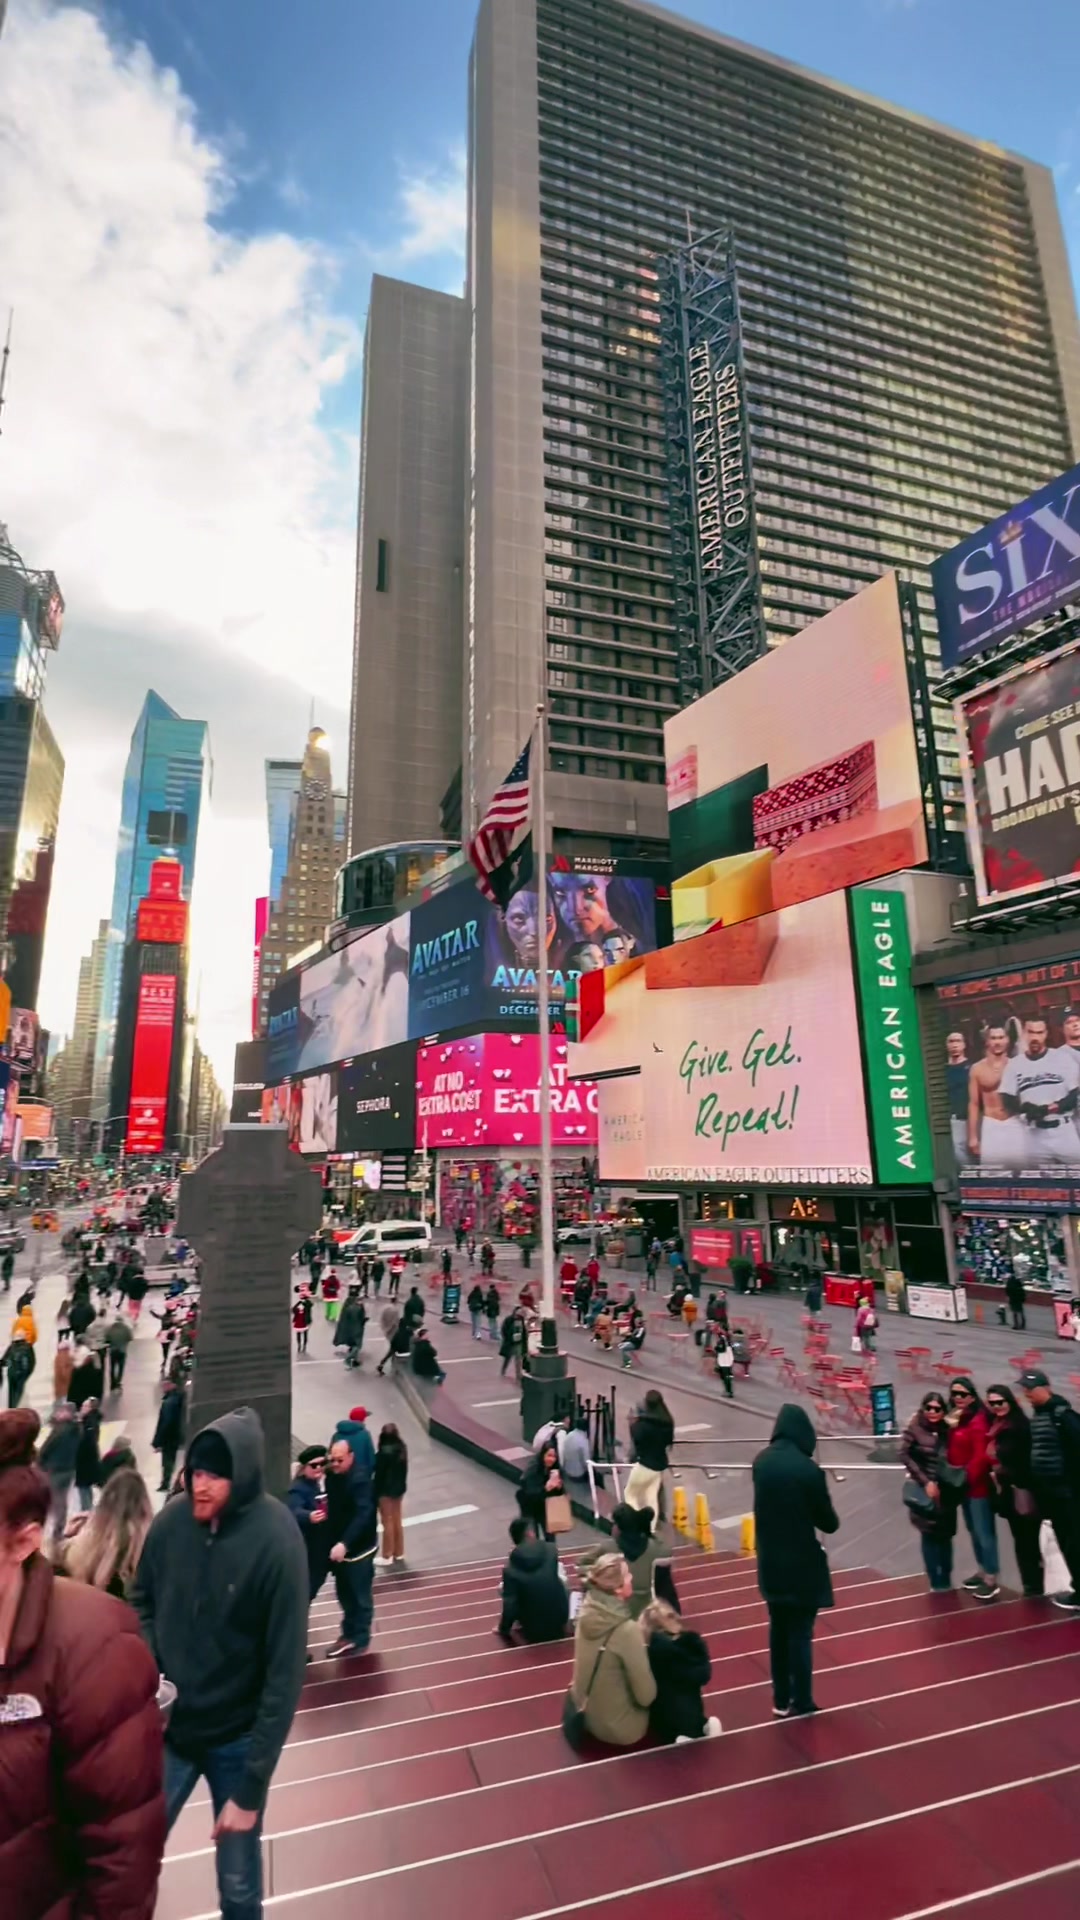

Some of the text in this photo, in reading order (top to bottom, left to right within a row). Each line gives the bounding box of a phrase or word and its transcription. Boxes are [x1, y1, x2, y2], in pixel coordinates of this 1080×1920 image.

[689, 340, 723, 570] AMERICAN EAGLE
[714, 362, 747, 528] OUTFITTERS
[955, 484, 1080, 625] SIX
[411, 920, 480, 975] AVATAR
[679, 1025, 802, 1094] Give. Get.
[871, 901, 916, 1169] AMERICAN EAGLE
[356, 1097, 391, 1114] SEPHORA
[418, 1096, 451, 1116] EXTRA
[694, 1085, 800, 1152] Repeat!
[648, 1167, 874, 1184] AMERICAN EAGLE OUTFITTERS
